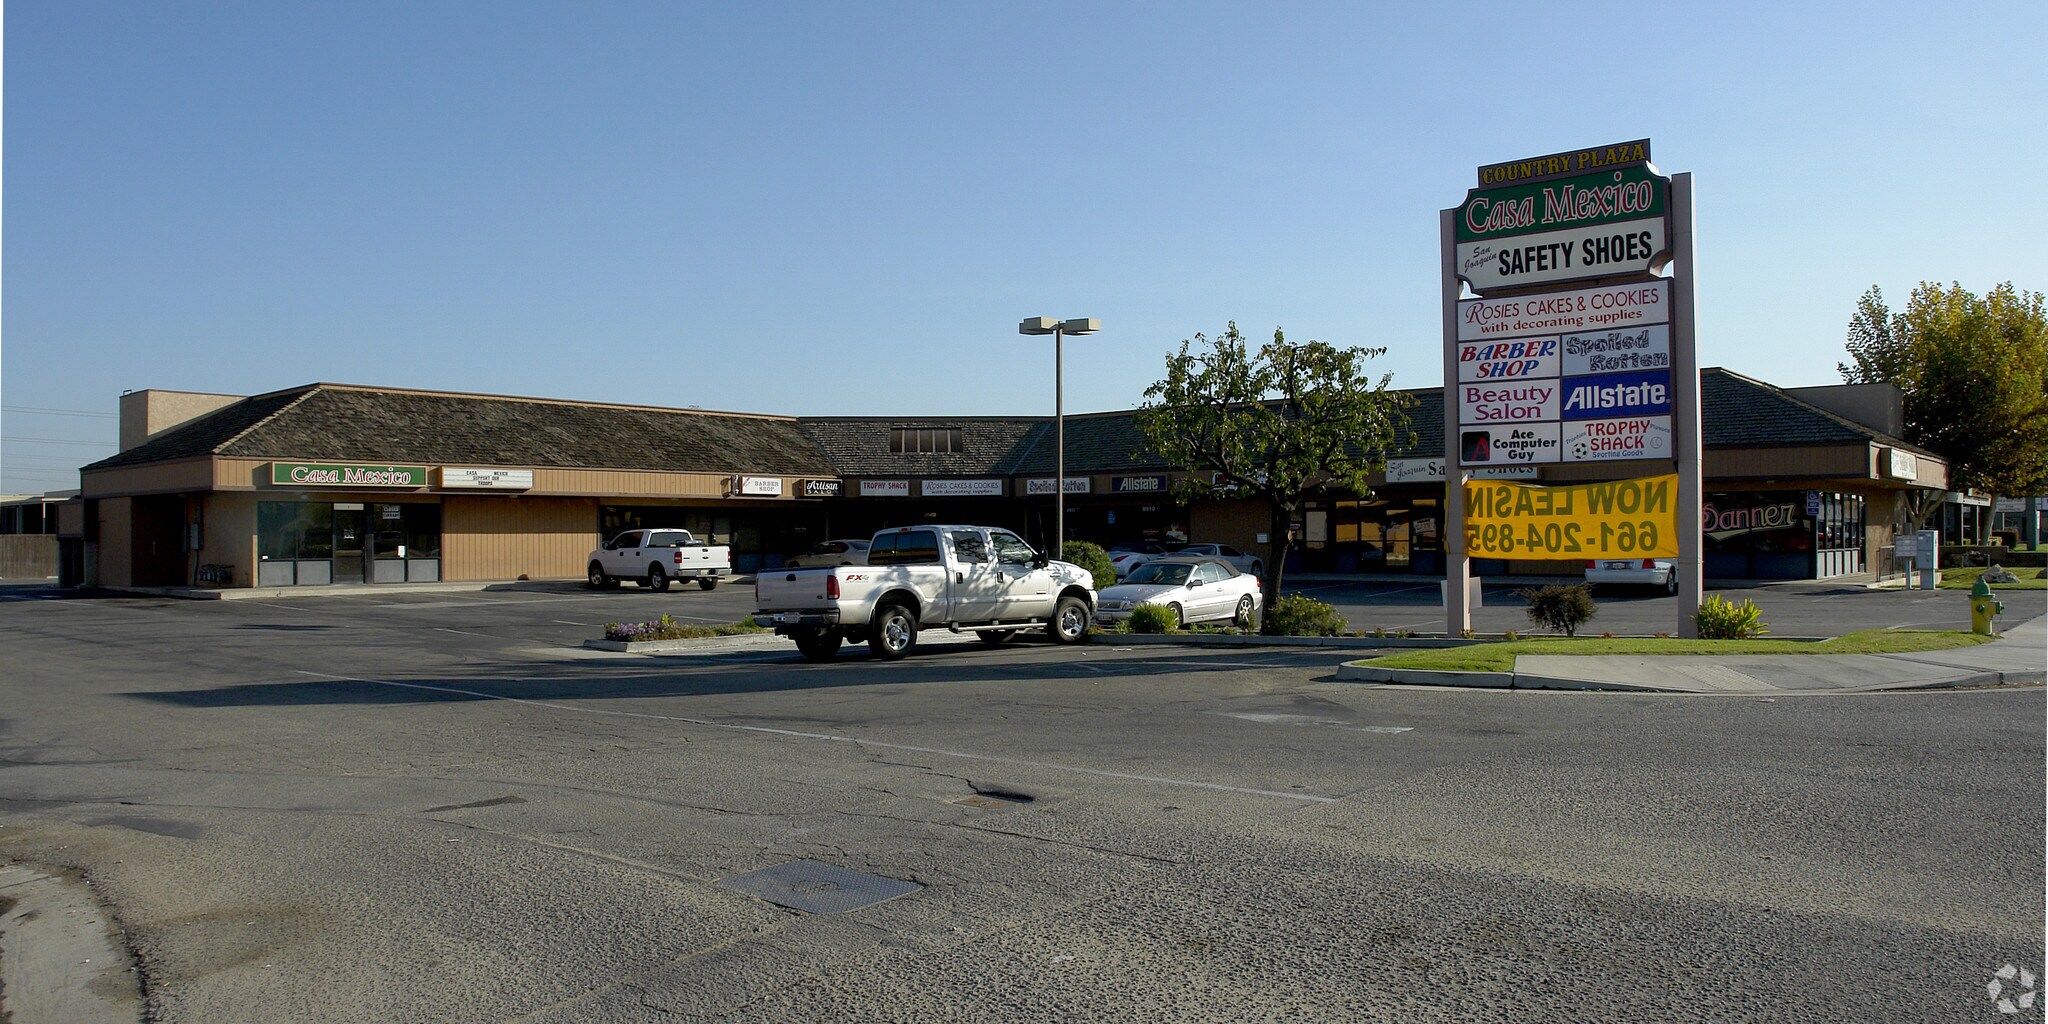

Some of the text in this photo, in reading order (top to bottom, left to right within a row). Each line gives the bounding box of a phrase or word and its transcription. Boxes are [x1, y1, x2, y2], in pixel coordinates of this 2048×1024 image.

[1482, 143, 1646, 184] COUNTRY PLAZA
[1466, 171, 1653, 233] Casa Mexico
[1473, 246, 1491, 259] San
[1498, 230, 1652, 276] SAFETY SHOES
[1464, 252, 1498, 273] Joaquin
[1465, 288, 1659, 325] ROSIES CAKES & COOKIES
[1481, 309, 1643, 333] with decorating supplies
[1460, 340, 1557, 362] BARBER
[1566, 329, 1649, 356] Spoiled
[1476, 359, 1540, 379] SHOP
[1590, 353, 1668, 371] Rotten
[1466, 385, 1553, 404] Beauty
[1564, 381, 1667, 411] Allstate
[1474, 403, 1542, 421] Salon
[1511, 429, 1534, 439] Ace
[1585, 419, 1651, 437] TROPHY
[1493, 438, 1557, 451] Computer
[1590, 435, 1645, 451] SHACK
[1508, 449, 1535, 462] Guy
[1592, 449, 1644, 458] Sporting Goods
[291, 466, 411, 485] Casa Mexico
[1389, 461, 1404, 473] San
[806, 480, 839, 490] Artisan
[1120, 476, 1159, 491] Allstate
